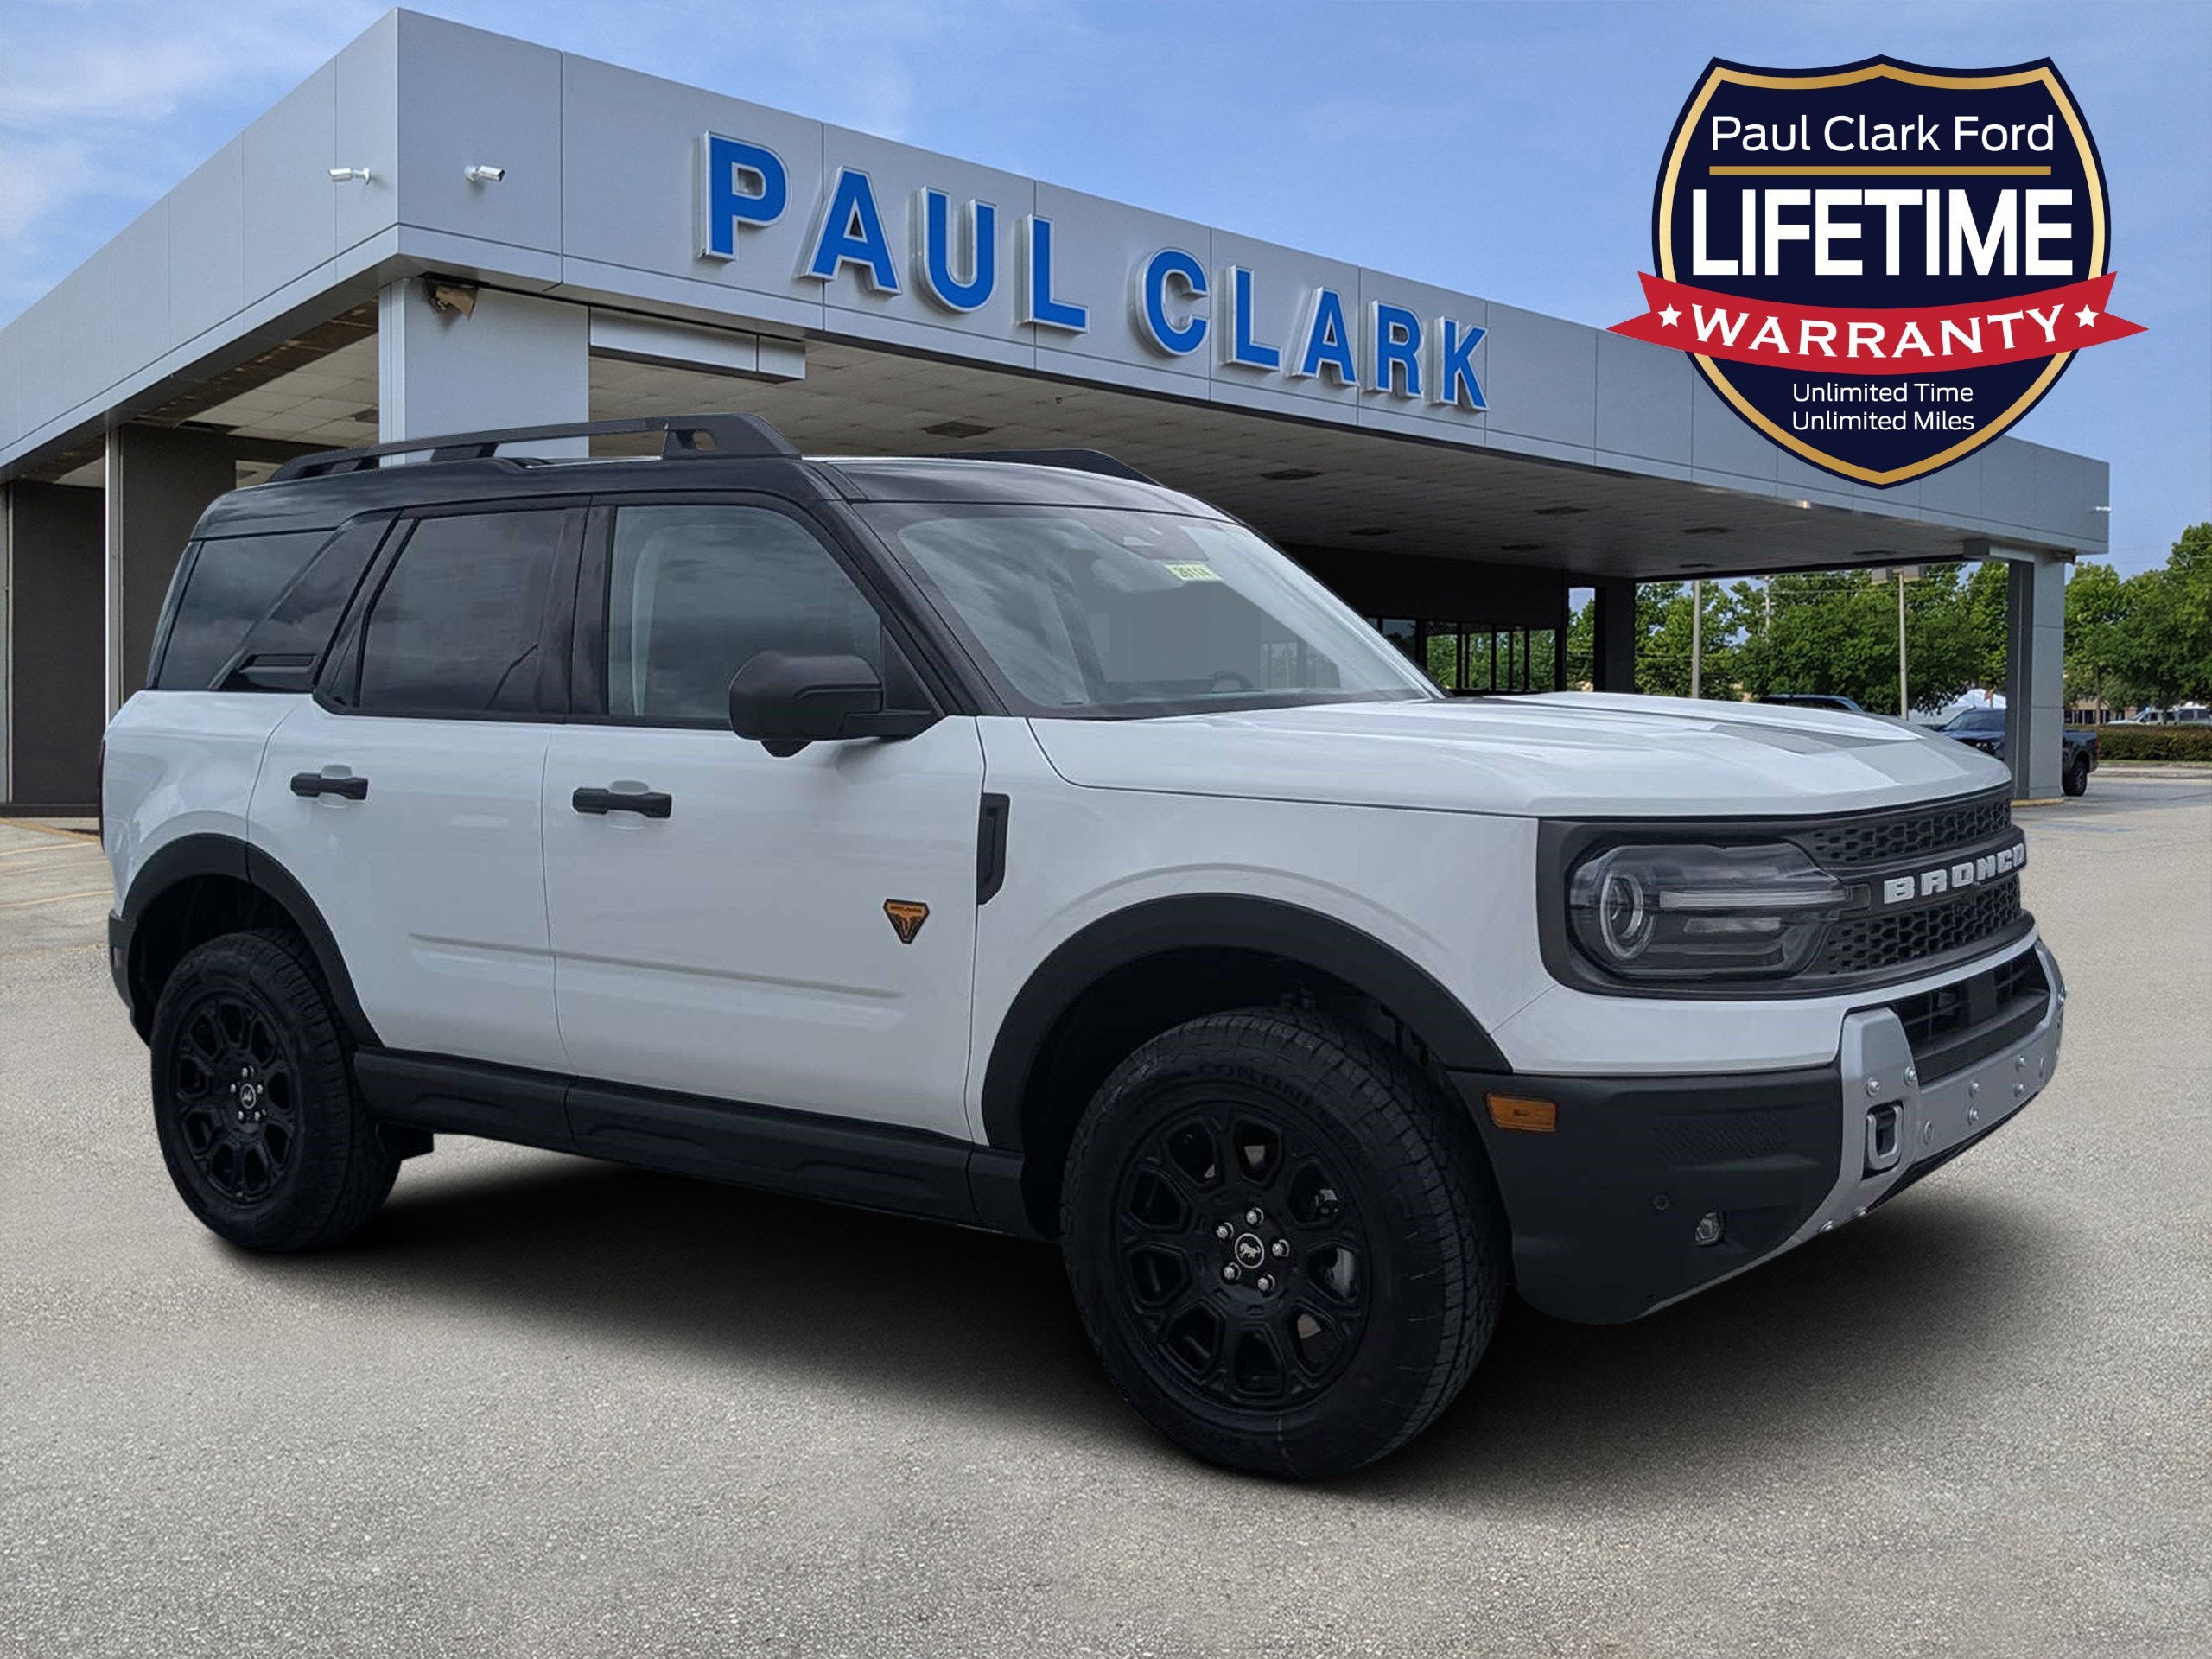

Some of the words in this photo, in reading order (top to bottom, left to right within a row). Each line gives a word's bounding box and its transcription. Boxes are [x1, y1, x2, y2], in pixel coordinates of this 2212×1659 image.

[703, 130, 1089, 333] PAUL
[1138, 247, 1490, 411] CLARK
[1883, 842, 2025, 905] BRONCO
